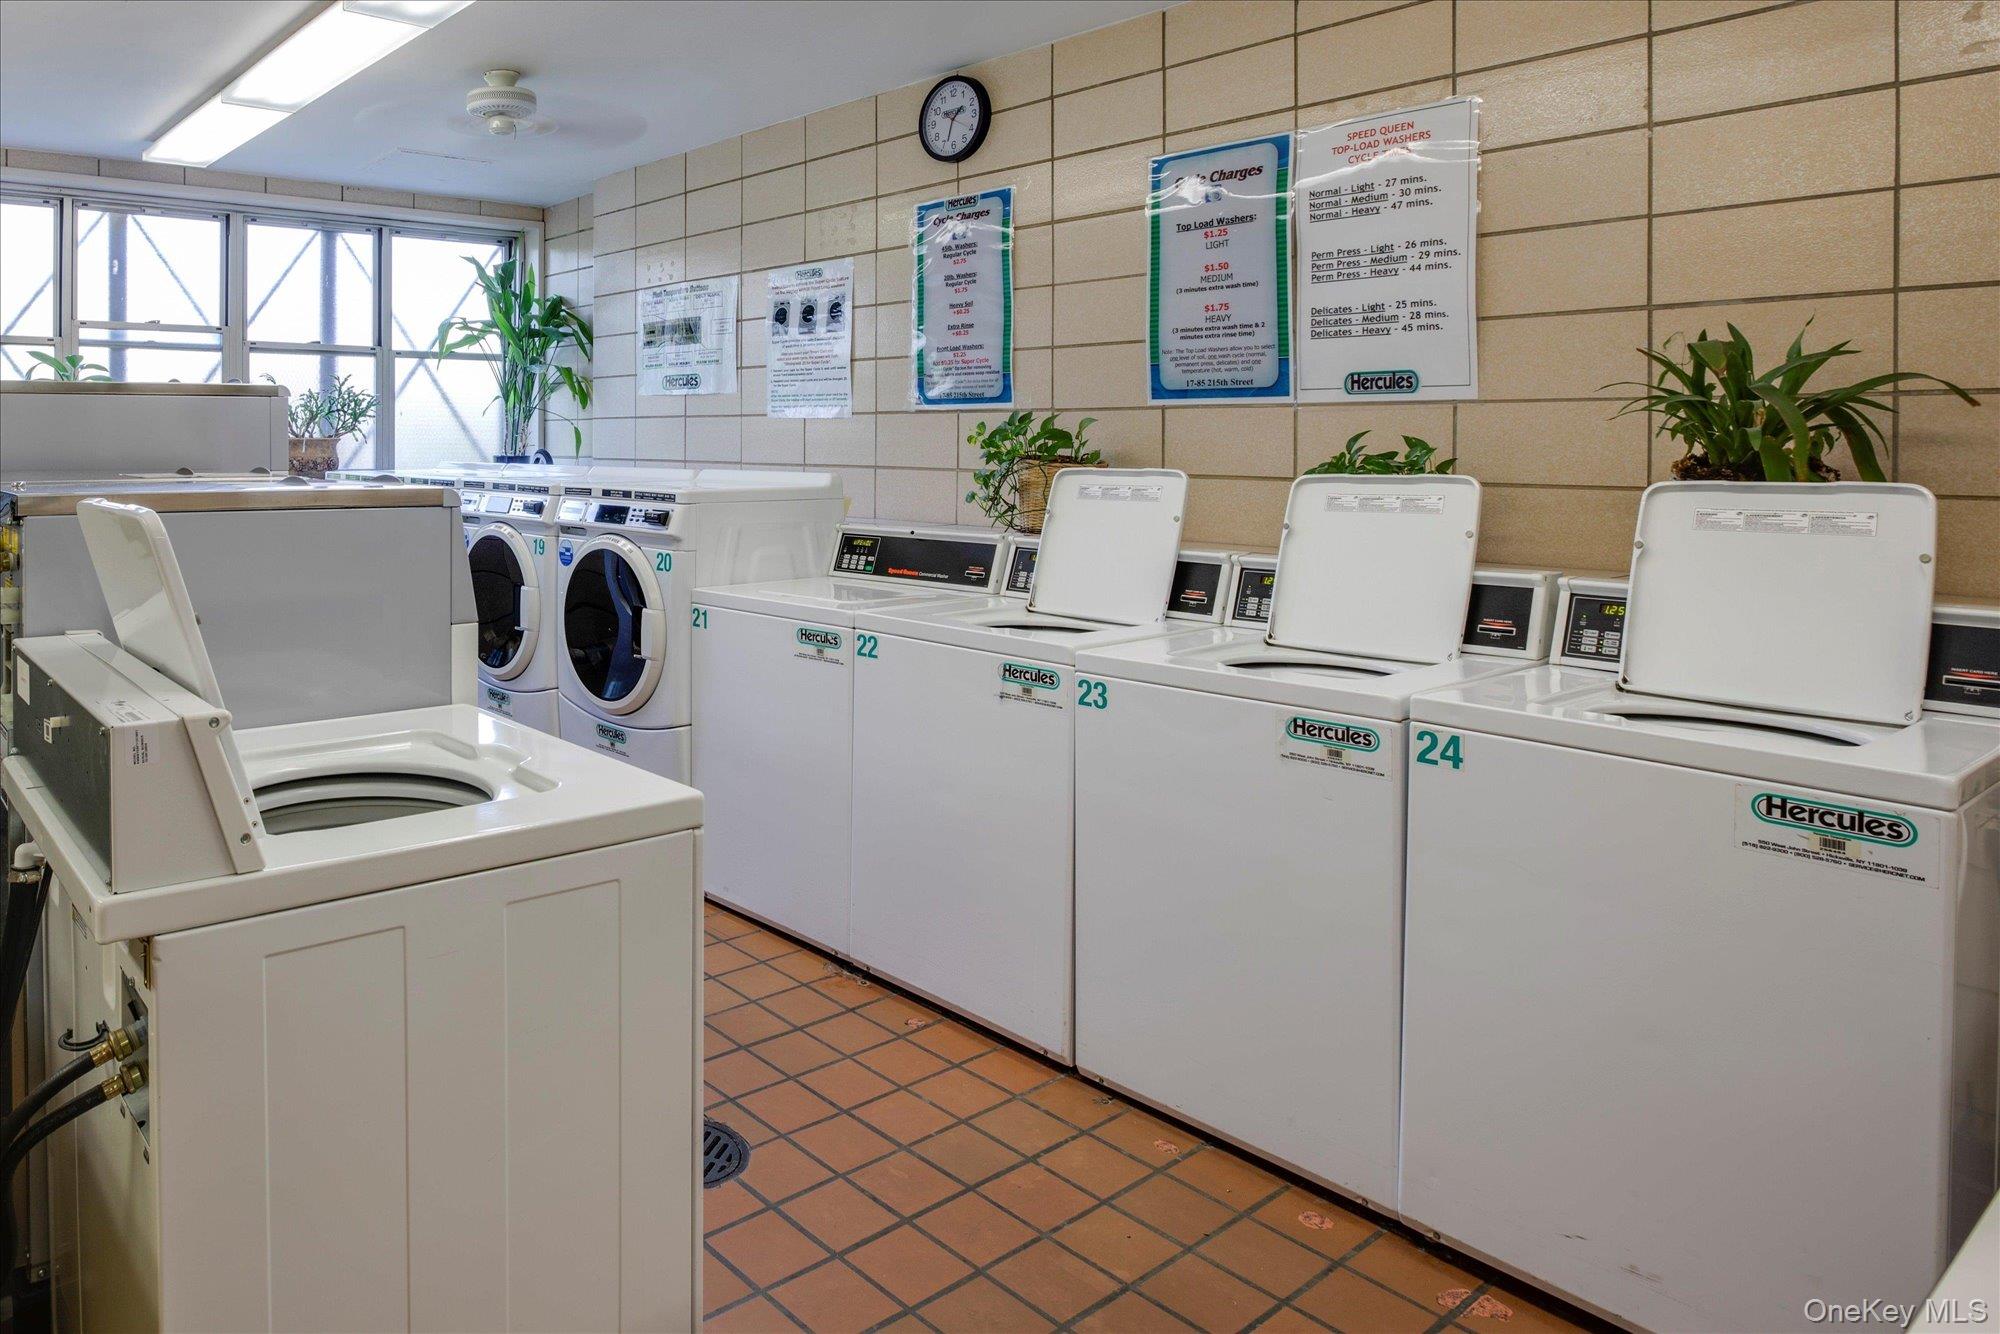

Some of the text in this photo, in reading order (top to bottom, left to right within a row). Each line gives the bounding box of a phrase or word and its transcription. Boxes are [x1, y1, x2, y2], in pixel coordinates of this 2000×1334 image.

[940, 96, 946, 104] 11
[950, 88, 957, 98] 12
[962, 90, 966, 99] 1
[970, 98, 974, 106] 2
[971, 108, 977, 118] 3
[931, 120, 936, 130] 9
[1347, 121, 1414, 142] SPEED QUEEN
[934, 132, 940, 142] 8
[962, 134, 968, 144] 5
[1332, 140, 1380, 156] TOP-LOAD
[1383, 130, 1432, 146] WASHERS
[942, 140, 946, 149] 7
[951, 140, 956, 150] 6
[1210, 166, 1264, 182] Charges
[1309, 175, 1427, 199] Normal Light 27 mins.
[948, 195, 976, 209] Hercules
[1309, 184, 1442, 210] Normal Medium 30 mins.
[956, 209, 990, 221] Charges
[1309, 198, 1434, 221] Normal Heavy 47 mins.
[1176, 214, 1257, 232] Top Load Washers:
[1204, 228, 1228, 240] $1.25
[1205, 239, 1230, 250] LIGHT
[1311, 238, 1447, 260] Perm Press Light 26 mins.
[1311, 248, 1462, 271] Perm Press Medium 29 mins.
[1204, 262, 1229, 272] $1.50
[1311, 261, 1452, 282] Perm Press Heavy 44 mins.
[1200, 273, 1234, 284] MEDIUM
[1184, 285, 1207, 293] minutes
[1242, 280, 1259, 288] time)
[1204, 302, 1230, 312] $1.75
[1310, 298, 1437, 316] Delicates Light 25 mins.
[1204, 314, 1232, 323] HEAVY
[1310, 310, 1449, 328] Delicates Medium 28 mins.
[1180, 325, 1204, 334] minutes
[1204, 324, 1220, 332] extra
[1222, 323, 1238, 331] wash
[1180, 332, 1204, 340] minutes
[1238, 330, 1256, 338] time)
[1310, 322, 1444, 338] Delicates Heavy 45 mins.
[665, 375, 698, 389] Hercules
[1186, 378, 1254, 387] 17-85 215th Street
[1350, 372, 1414, 390] Hercules
[533, 538, 545, 556] 19
[656, 552, 672, 572] 20
[1604, 606, 1624, 616] 1.25
[692, 608, 708, 629] 21
[800, 629, 838, 646] Hercules
[856, 634, 878, 658] 22
[1002, 663, 1056, 686] Hercules
[1078, 679, 1108, 710] 23
[1293, 718, 1372, 746] Hercules
[1416, 730, 1464, 770] 24
[1766, 795, 1904, 840] Hercules
[1786, 844, 1801, 852] John
